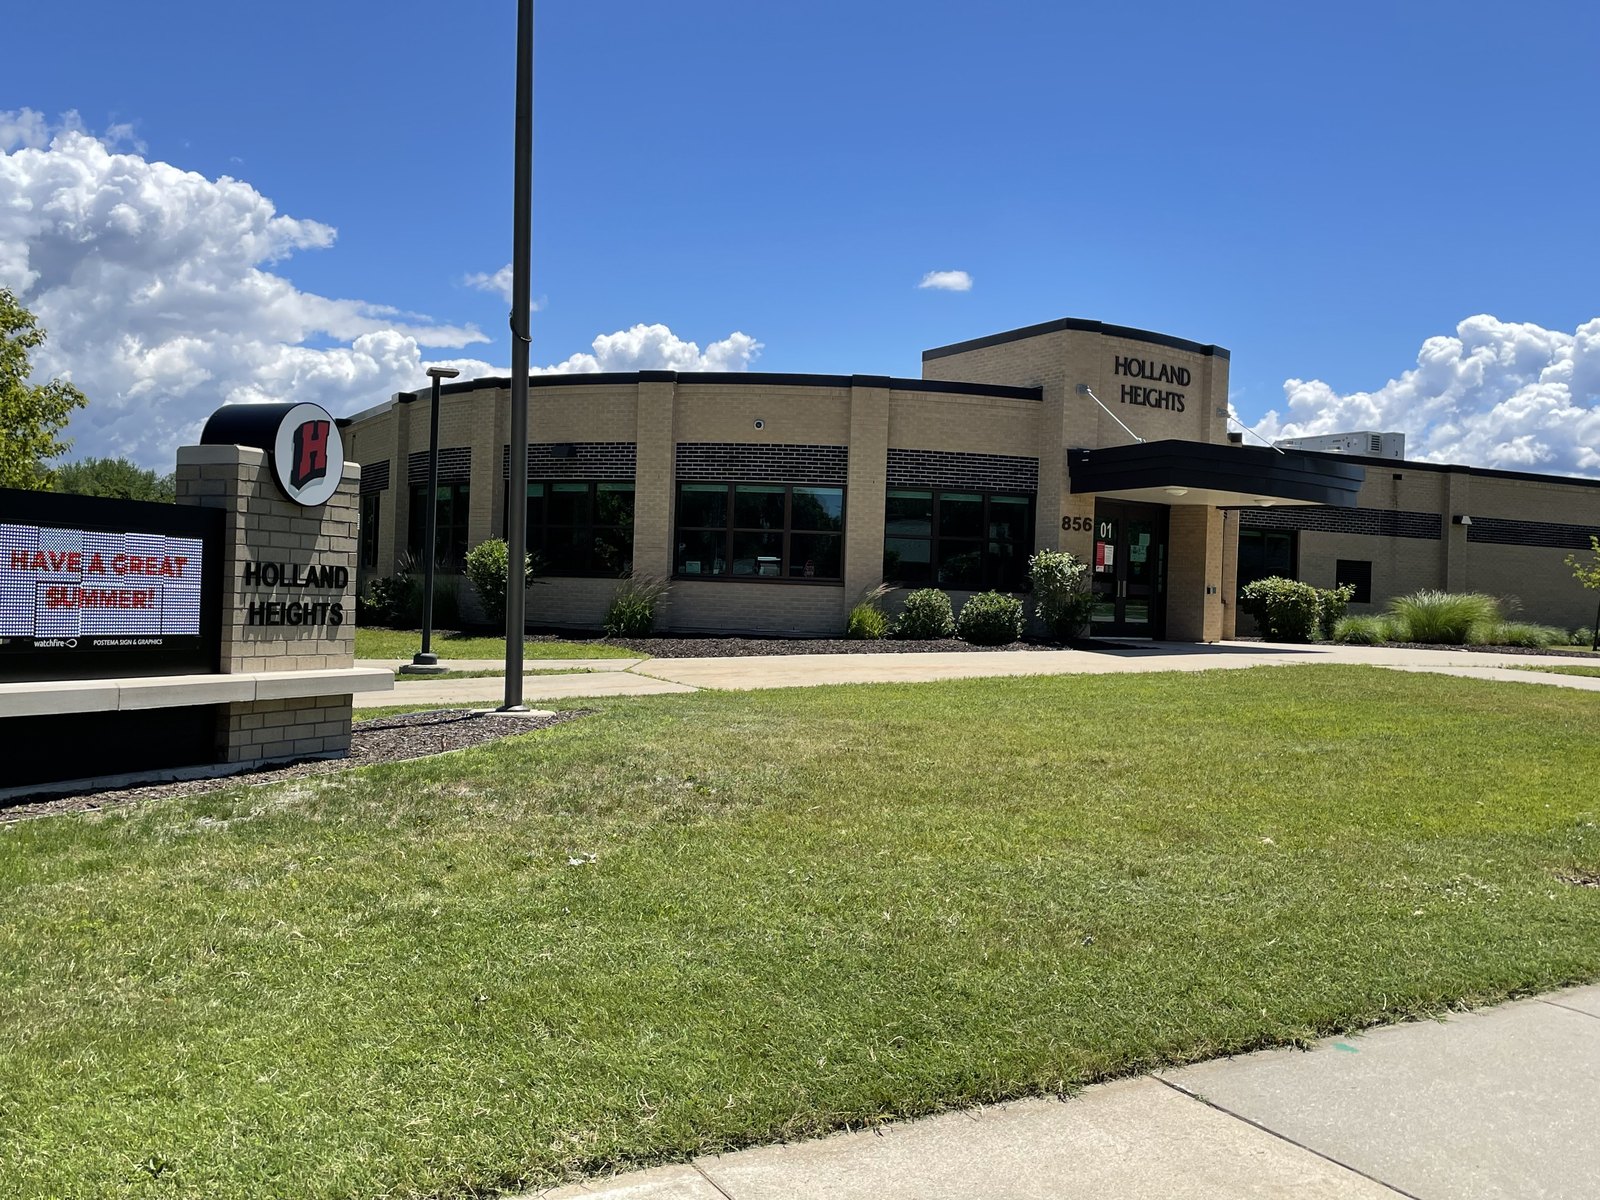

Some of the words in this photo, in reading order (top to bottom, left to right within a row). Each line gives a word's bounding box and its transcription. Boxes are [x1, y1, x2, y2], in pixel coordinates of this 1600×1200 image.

[1114, 355, 1191, 387] HOLLAND
[1120, 384, 1185, 413] HEIGHTS
[291, 420, 330, 490] H
[1061, 516, 1093, 532] 856
[1100, 522, 1112, 539] 01
[11, 550, 82, 574] HAVE
[88, 553, 105, 575] A
[111, 554, 189, 577] GREAT
[245, 561, 349, 589] HOLLAND
[46, 586, 155, 609] SUMMER!
[249, 602, 344, 627] HEIGHTS
[34, 639, 65, 648] watchfire
